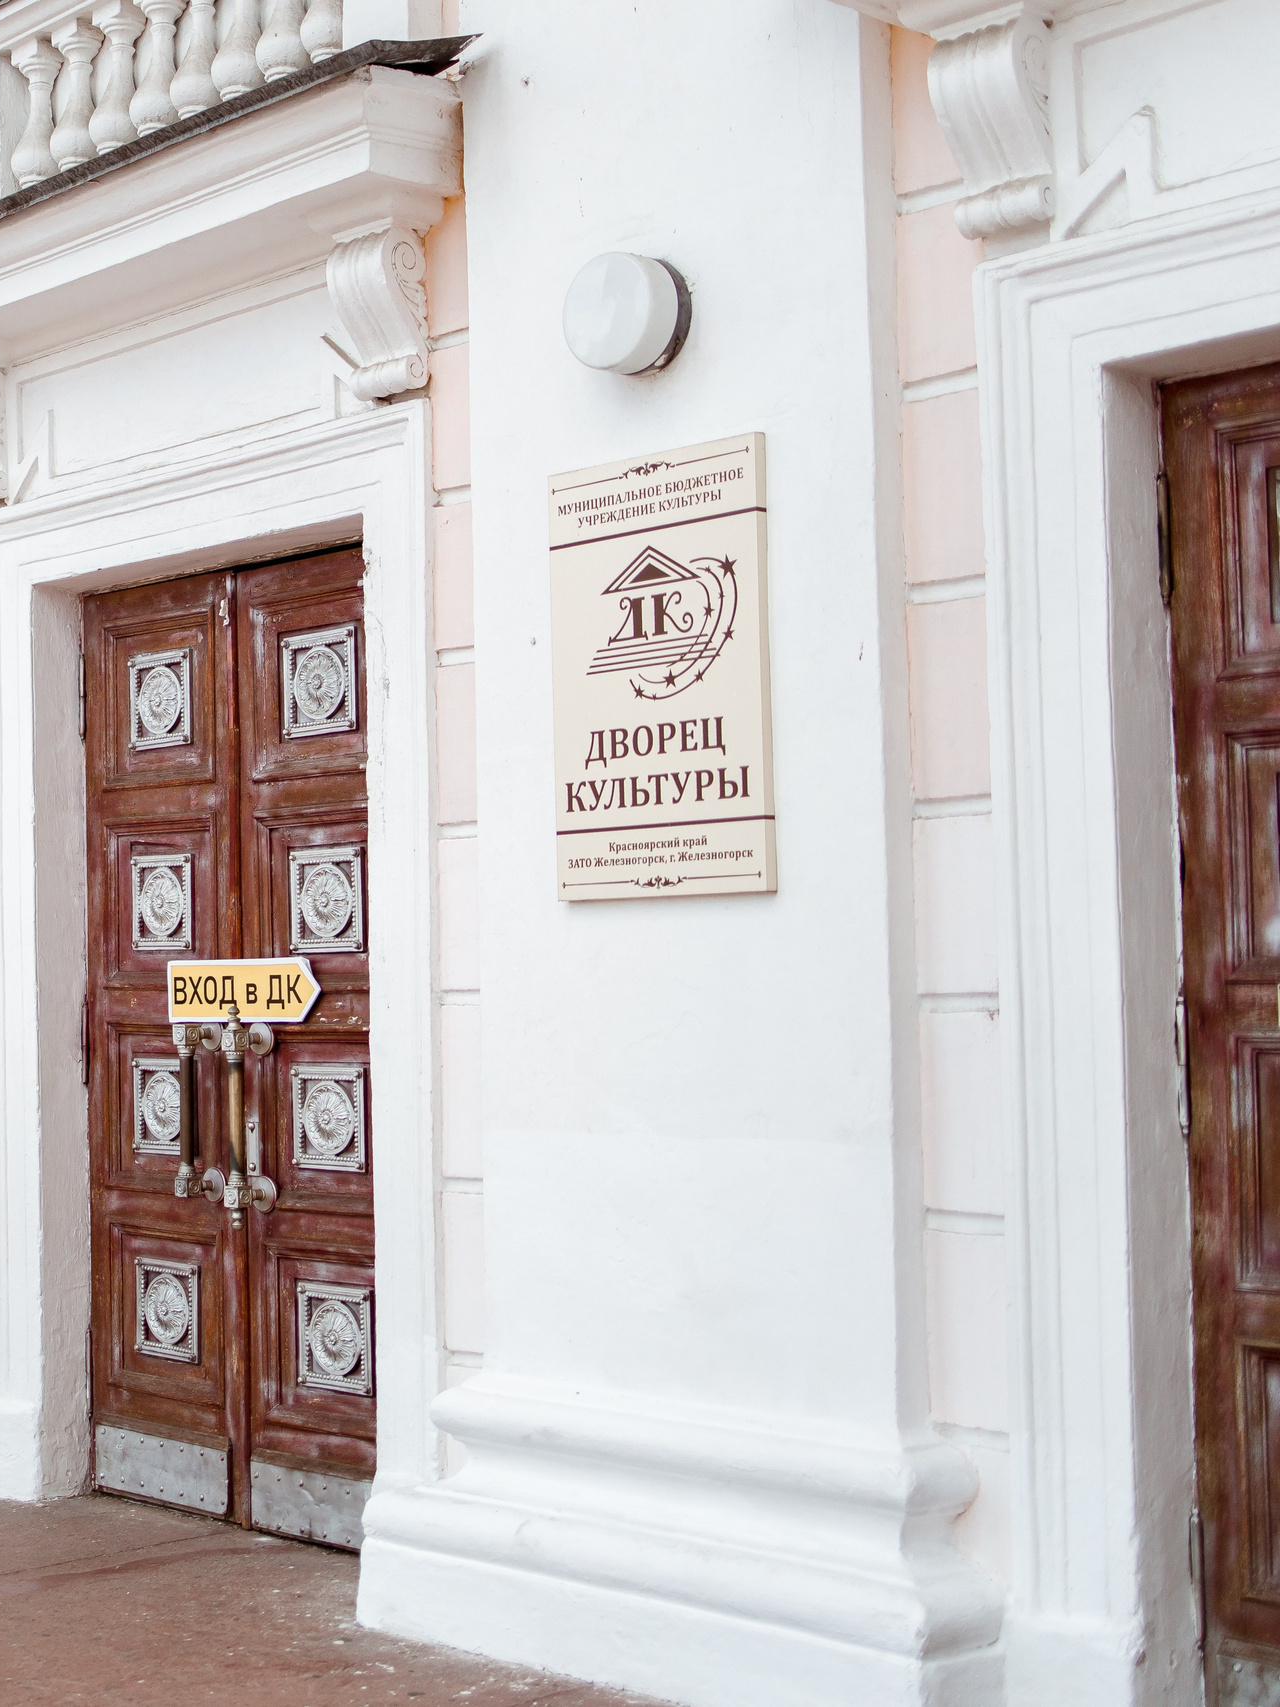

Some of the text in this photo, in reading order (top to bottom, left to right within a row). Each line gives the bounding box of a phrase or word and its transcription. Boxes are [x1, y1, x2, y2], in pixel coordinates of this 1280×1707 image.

[558, 467, 744, 516] МУНИЦИПАЛЬНОЕ БЮДЖЕТНОЕ
[578, 489, 722, 528] УЧРЕЖДЕНИЕ КУЛЬТУРЫ
[585, 716, 726, 770] ДВОРЕЦ
[565, 765, 751, 813] КУЛЬТУРЫ
[568, 849, 754, 869] ЗАТО Железногорск, г. Железногорск
[609, 835, 708, 855] Красноярский край
[173, 974, 303, 1010] ВХОД в ДК
